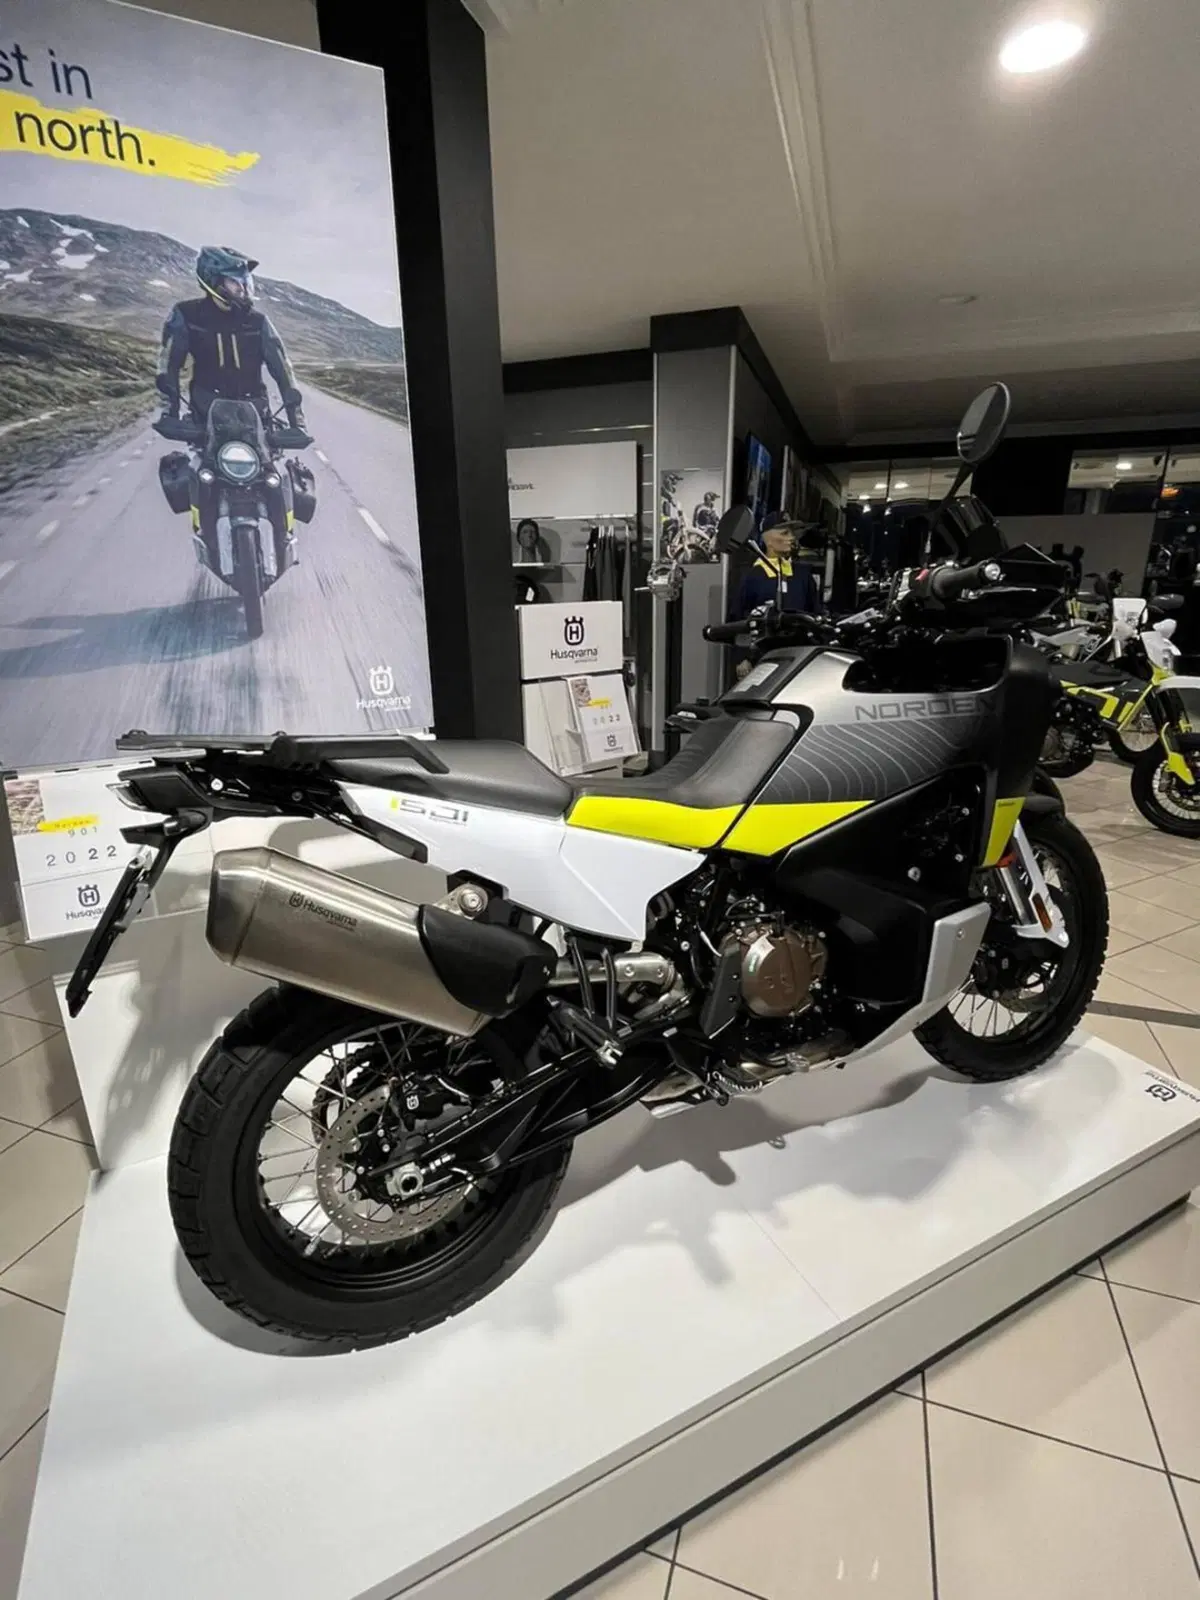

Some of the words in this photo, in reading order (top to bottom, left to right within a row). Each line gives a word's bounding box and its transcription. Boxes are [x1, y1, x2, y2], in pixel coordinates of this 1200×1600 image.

[48, 48, 93, 99] in
[15, 110, 156, 166] north.
[550, 648, 598, 660] Husqvarna
[356, 695, 411, 710] Husqvarna
[46, 844, 117, 867] 2022
[65, 907, 104, 920] Husqvar
[303, 899, 357, 927] Husqvarna
